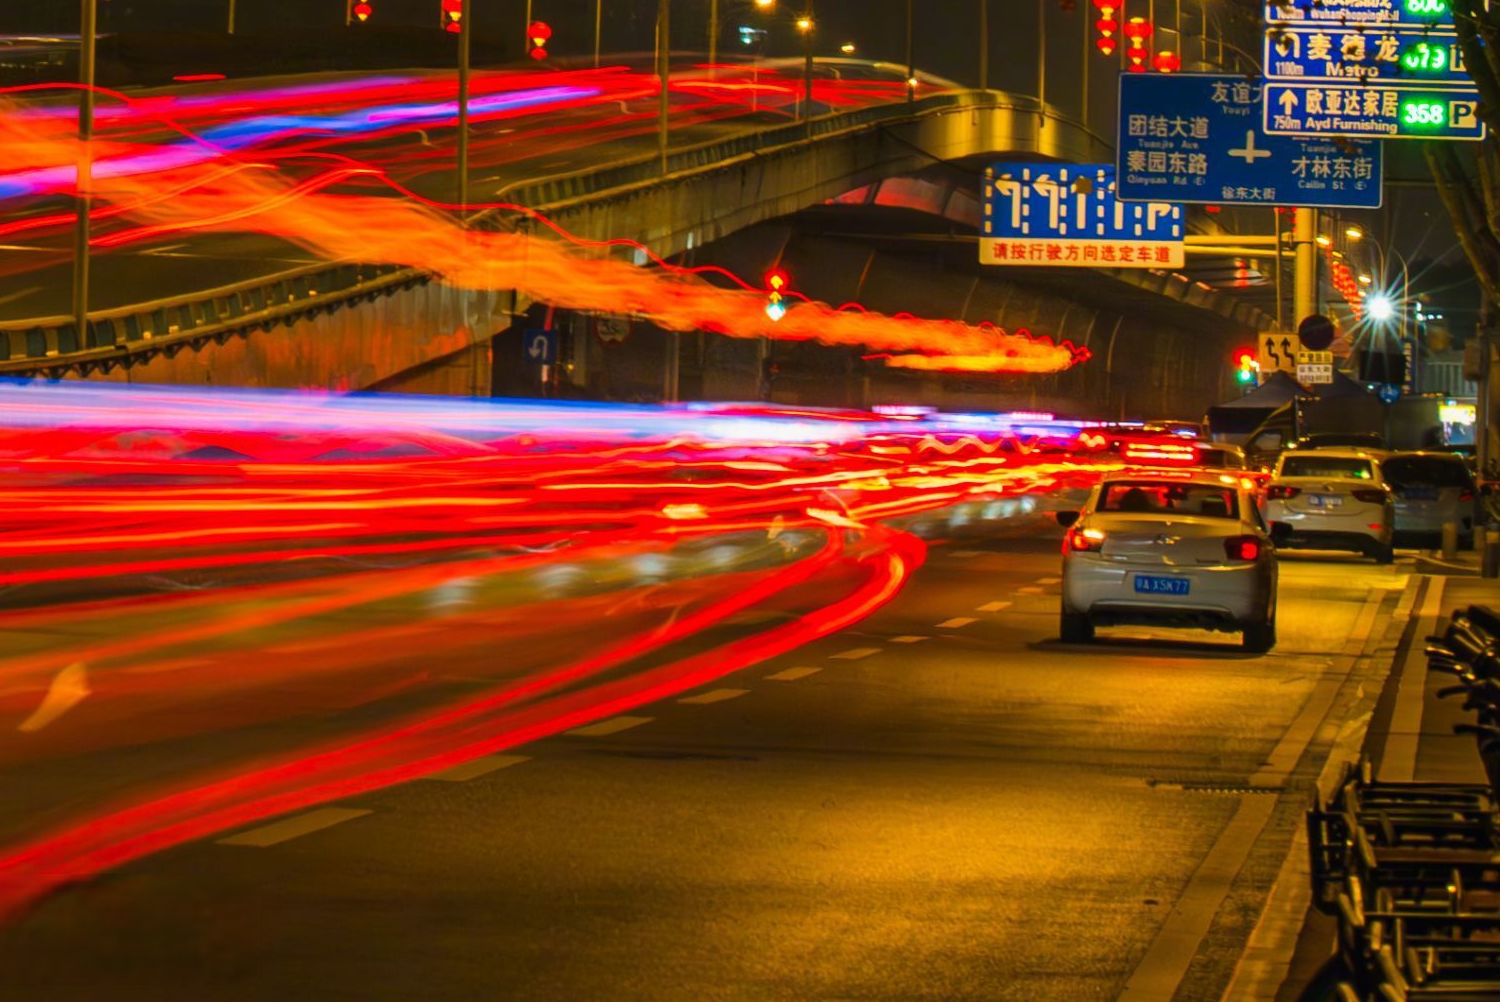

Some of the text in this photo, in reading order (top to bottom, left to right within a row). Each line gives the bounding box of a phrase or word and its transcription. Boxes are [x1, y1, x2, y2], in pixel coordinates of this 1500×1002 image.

[1307, 34, 1400, 62] 麦德龙
[1306, 89, 1399, 118] 欧亚达家居
[1404, 103, 1444, 124] 358
[1128, 114, 1209, 139] 团结大道
[1274, 115, 1301, 130] 750m
[1305, 117, 1398, 135] Ayd Furnishing
[1292, 156, 1373, 179] 才林东街
[993, 242, 1171, 263] 请按行驶方向选定车道
